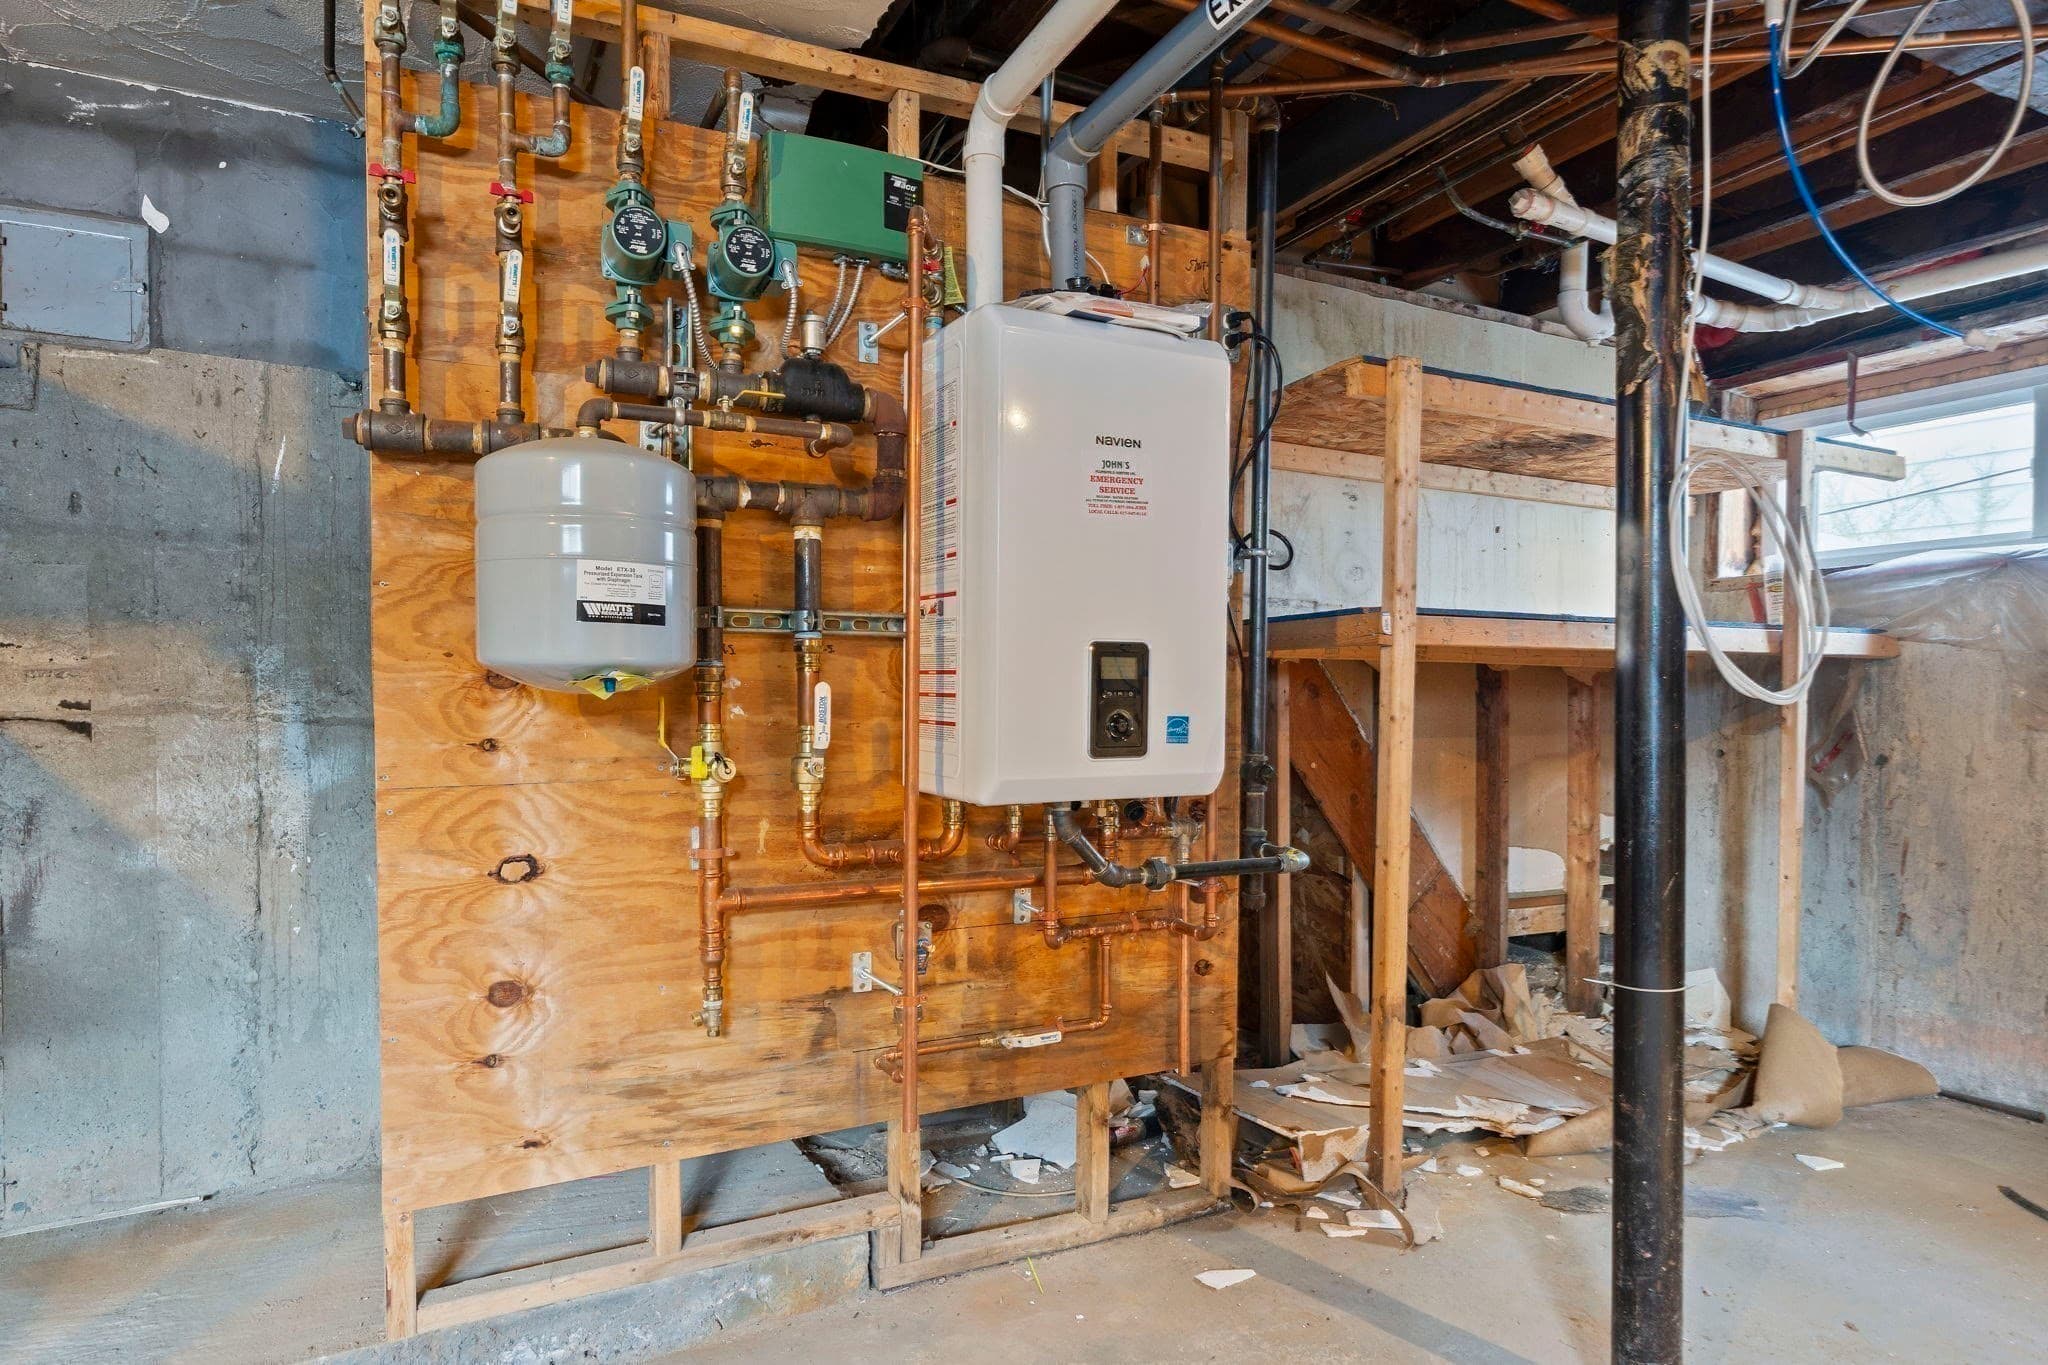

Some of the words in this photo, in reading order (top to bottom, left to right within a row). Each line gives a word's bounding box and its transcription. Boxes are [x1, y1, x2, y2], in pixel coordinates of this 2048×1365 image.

[1090, 475, 1144, 485] EMERGENCY
[704, 479, 716, 498] R
[1099, 486, 1136, 495] SERVICE
[600, 603, 633, 612] WATTS
